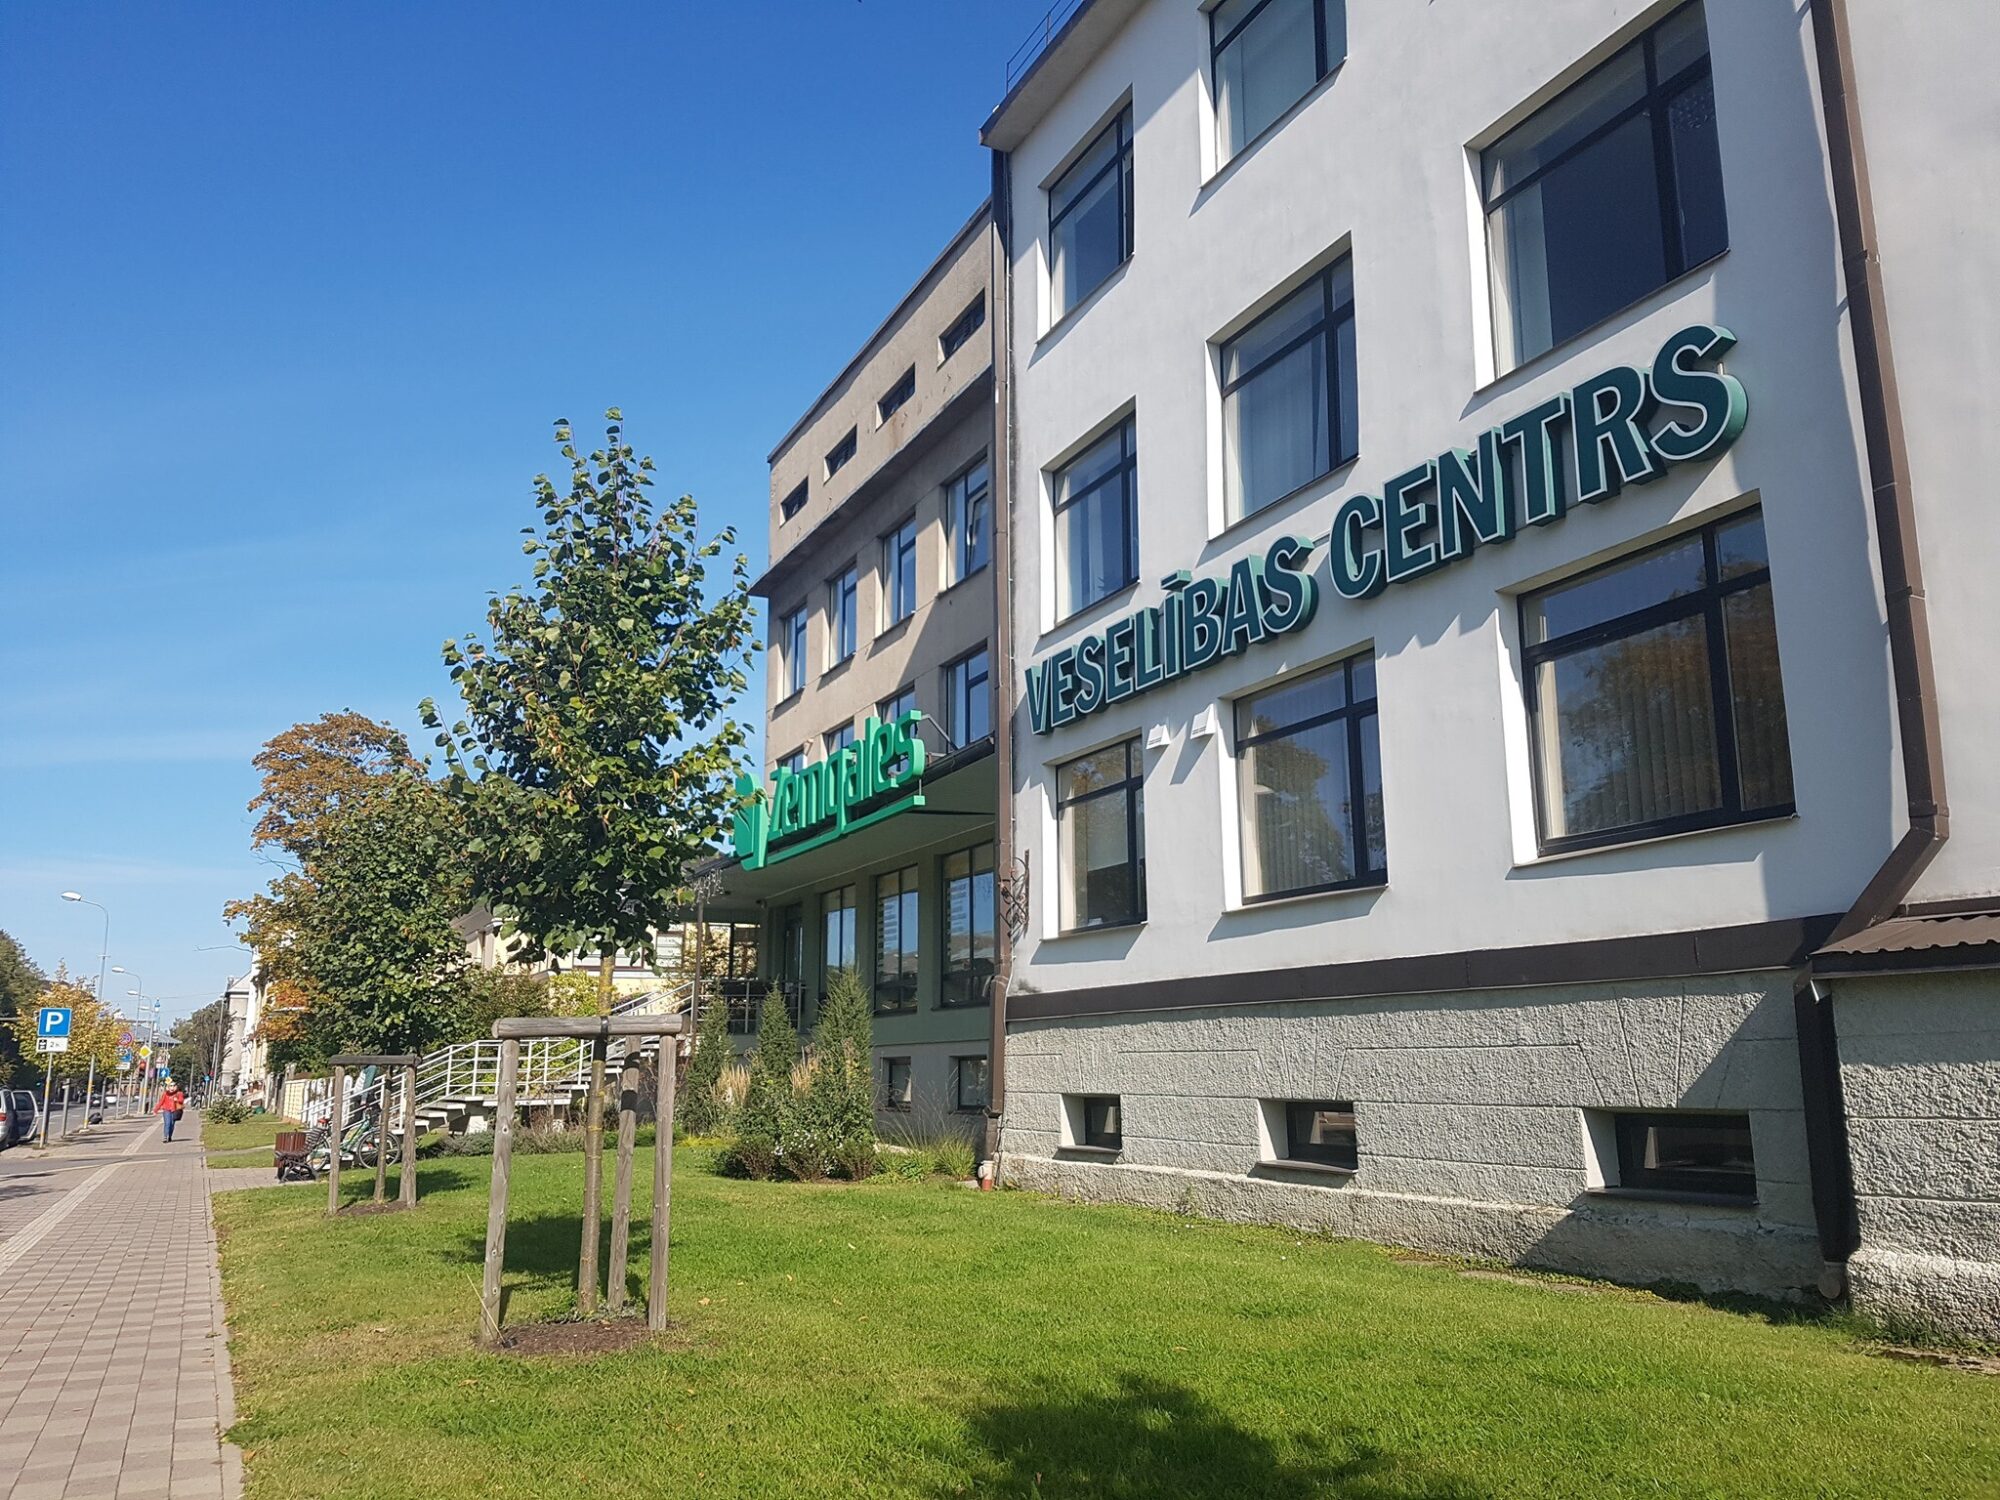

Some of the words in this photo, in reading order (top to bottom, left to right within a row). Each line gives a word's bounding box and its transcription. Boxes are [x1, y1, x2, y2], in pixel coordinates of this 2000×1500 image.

[1025, 535, 1318, 735] VESELĪBAS
[1329, 323, 1748, 600] CENTRS
[768, 709, 925, 841] Zemgales
[45, 1011, 64, 1033] P
